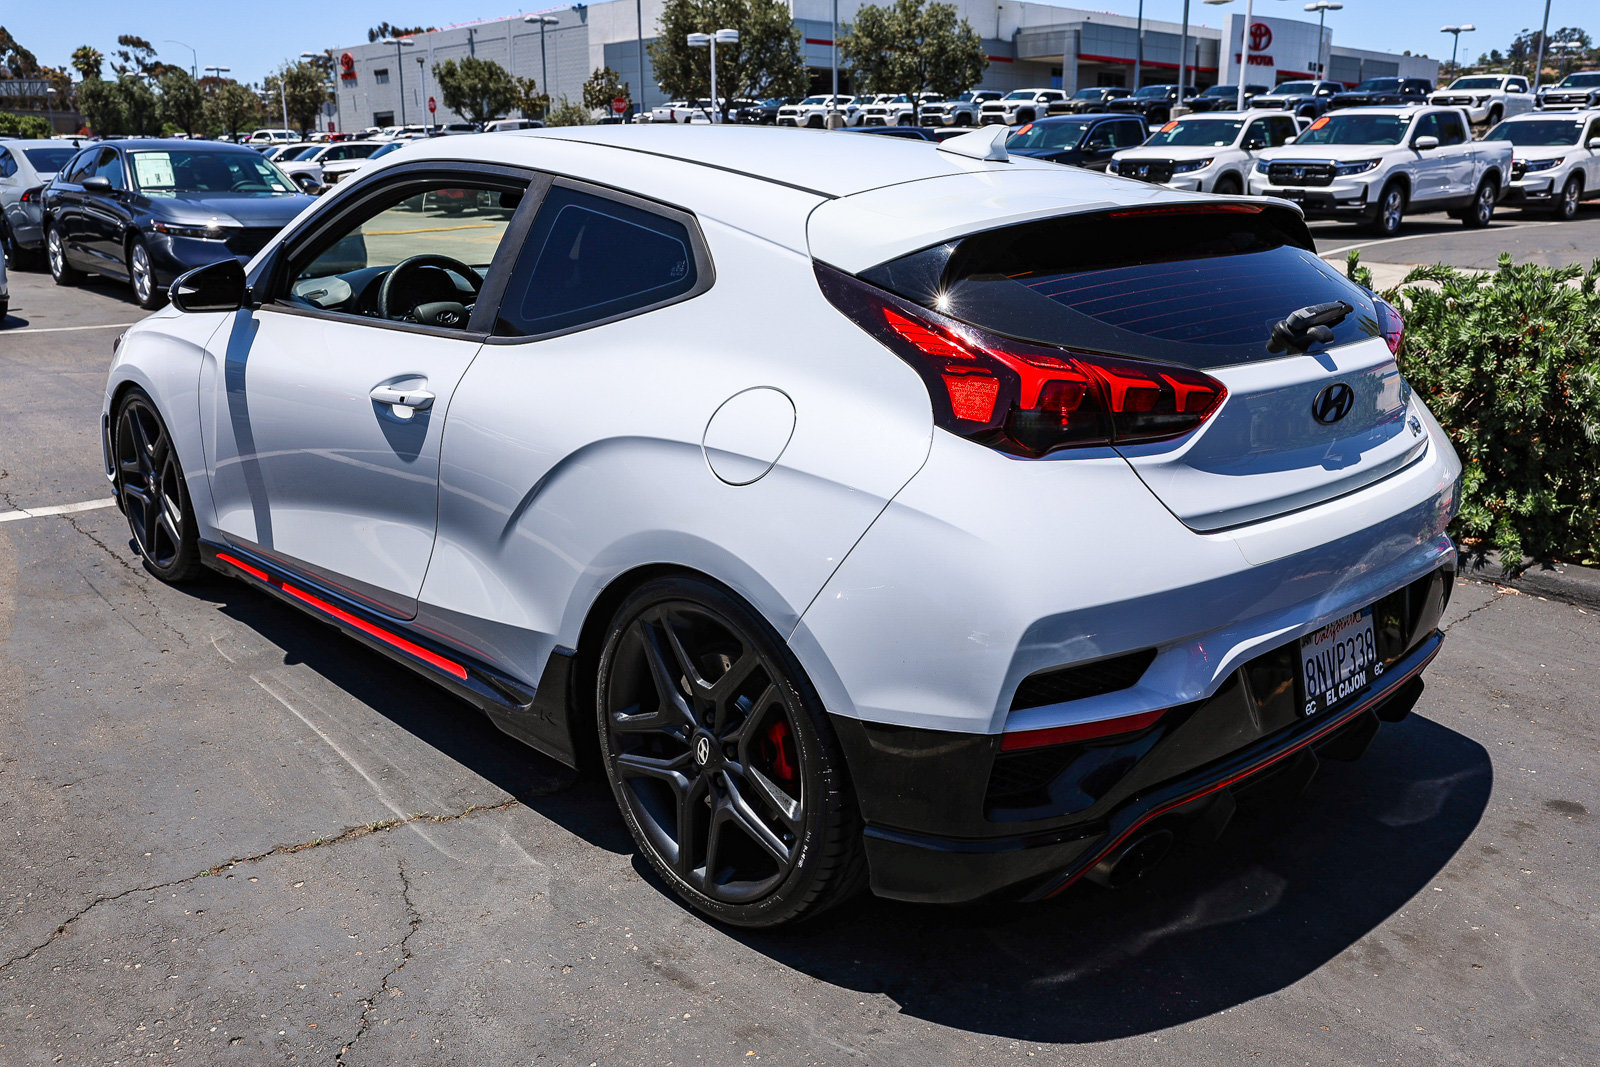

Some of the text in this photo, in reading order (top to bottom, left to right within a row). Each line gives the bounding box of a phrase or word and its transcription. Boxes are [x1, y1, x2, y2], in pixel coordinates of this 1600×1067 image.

[1235, 53, 1274, 66] TYOTA
[1305, 627, 1375, 698] 8NVP338
[1326, 690, 1338, 706] EL
[1338, 670, 1367, 699] CAJON
